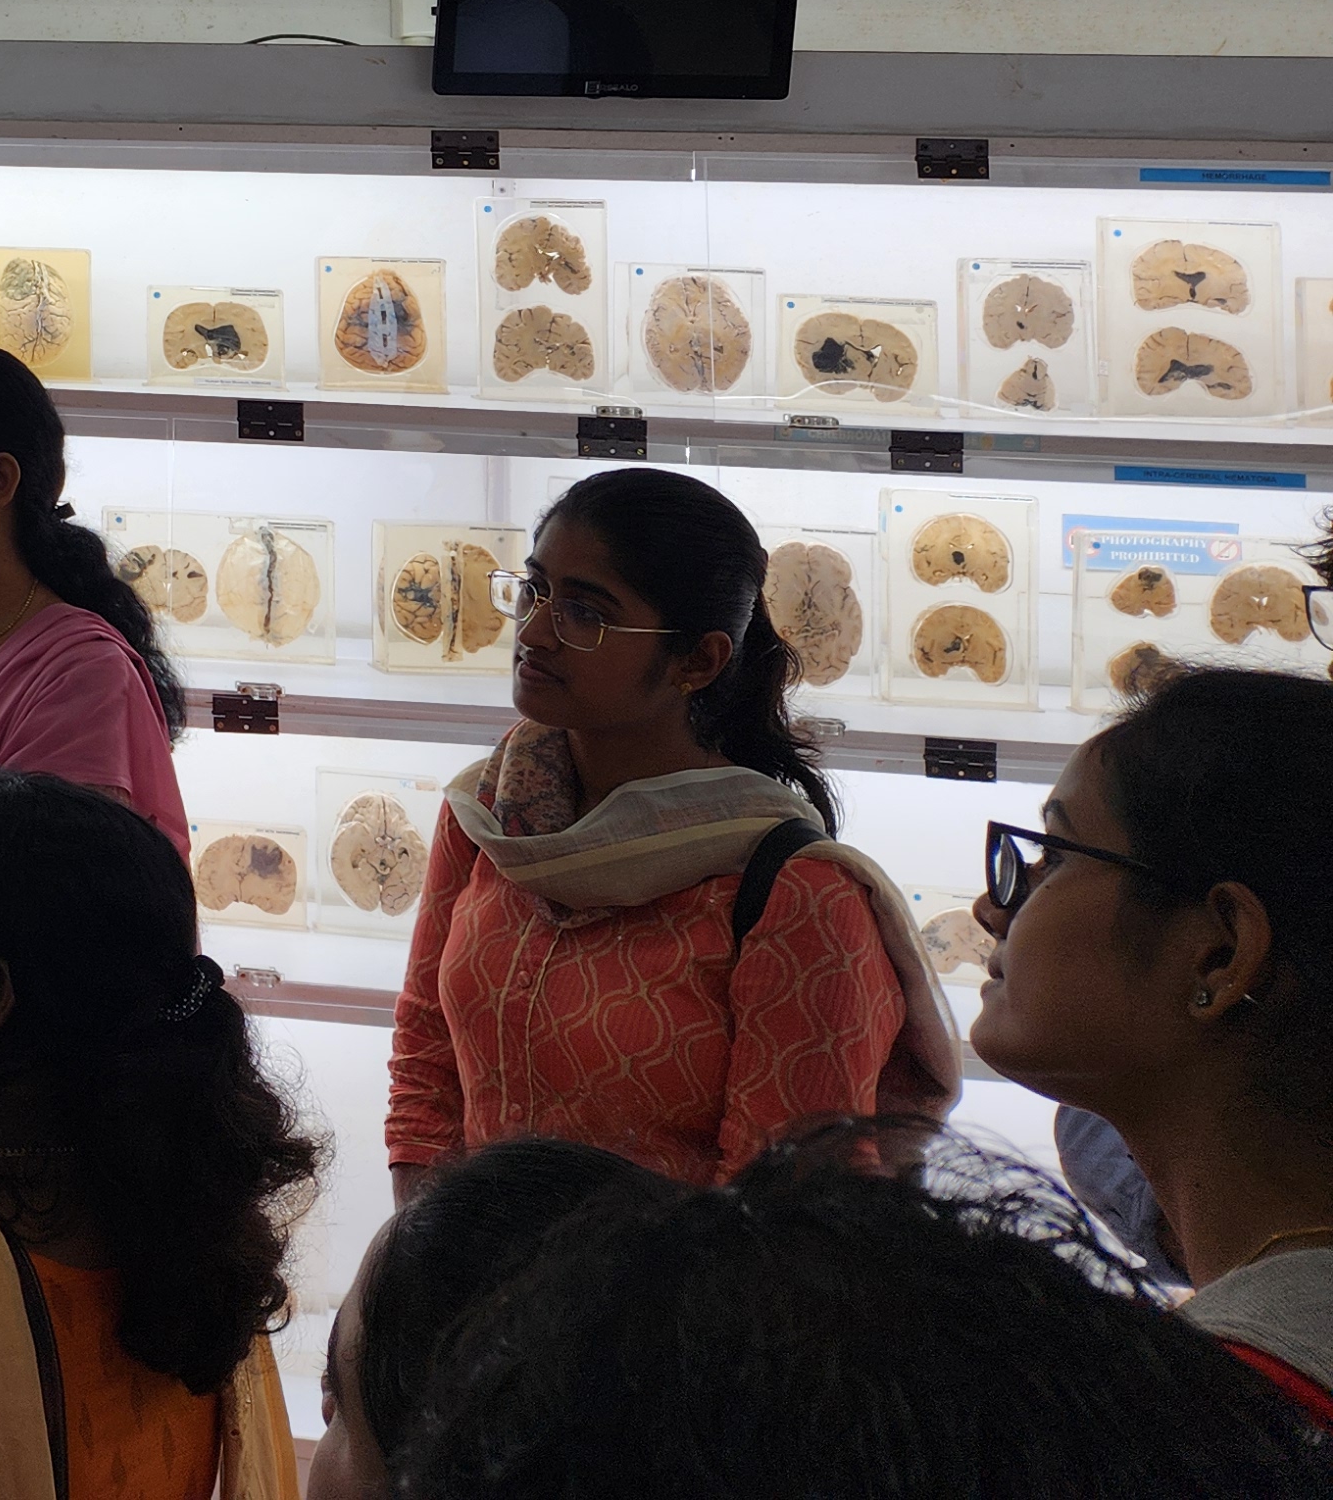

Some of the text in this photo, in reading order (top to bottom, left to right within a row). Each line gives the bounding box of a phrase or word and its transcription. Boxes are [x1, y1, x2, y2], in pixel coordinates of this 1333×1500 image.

[1201, 172, 1268, 182] HEMORRHAGE
[1143, 470, 1278, 485] INTRA-CEREBRAL HEMATOMA
[1101, 534, 1207, 550] PHOTOGRAPHY
[1110, 550, 1200, 564] PROHIBITED
